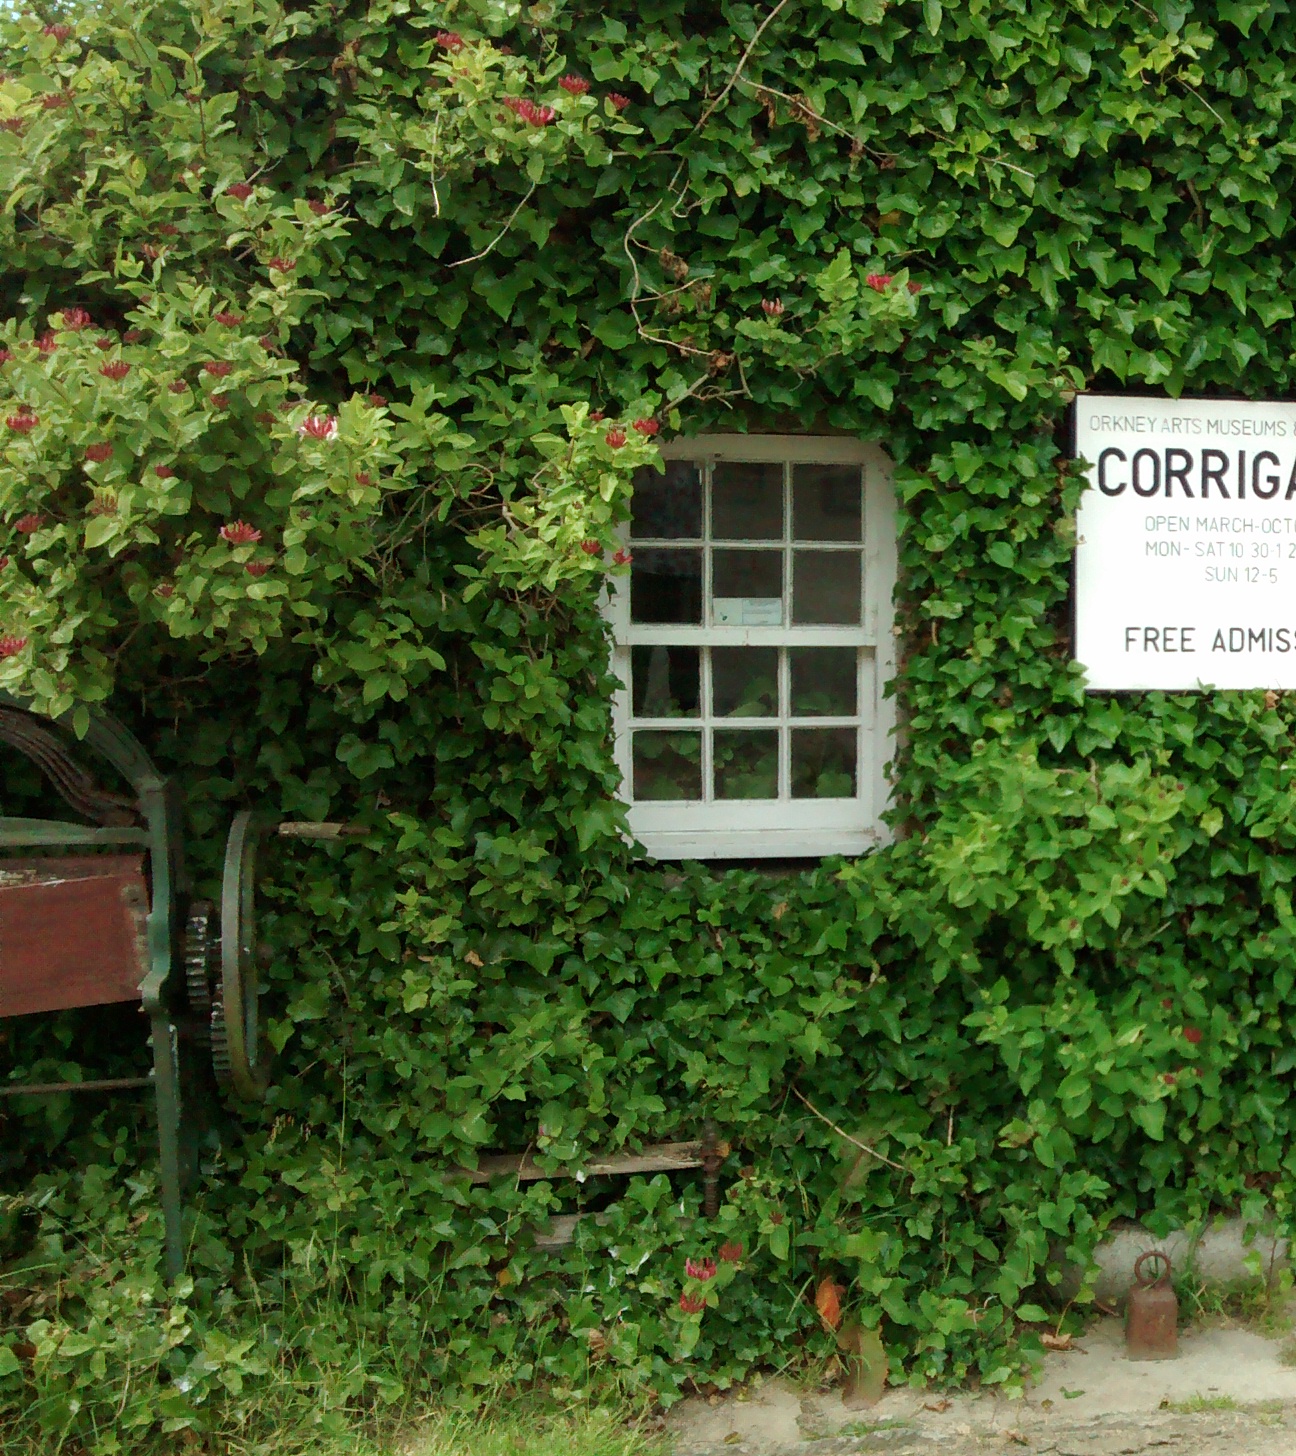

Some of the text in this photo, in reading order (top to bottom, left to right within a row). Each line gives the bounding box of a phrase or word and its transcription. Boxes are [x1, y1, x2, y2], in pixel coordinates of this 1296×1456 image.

[1090, 415, 1157, 433] ORKNEY
[1161, 417, 1202, 434] ARTS
[1207, 419, 1287, 436] MUSEUMS
[1145, 516, 1190, 532] OPEN
[1205, 566, 1278, 584] SUN 12-5
[1125, 626, 1196, 652] FREE
